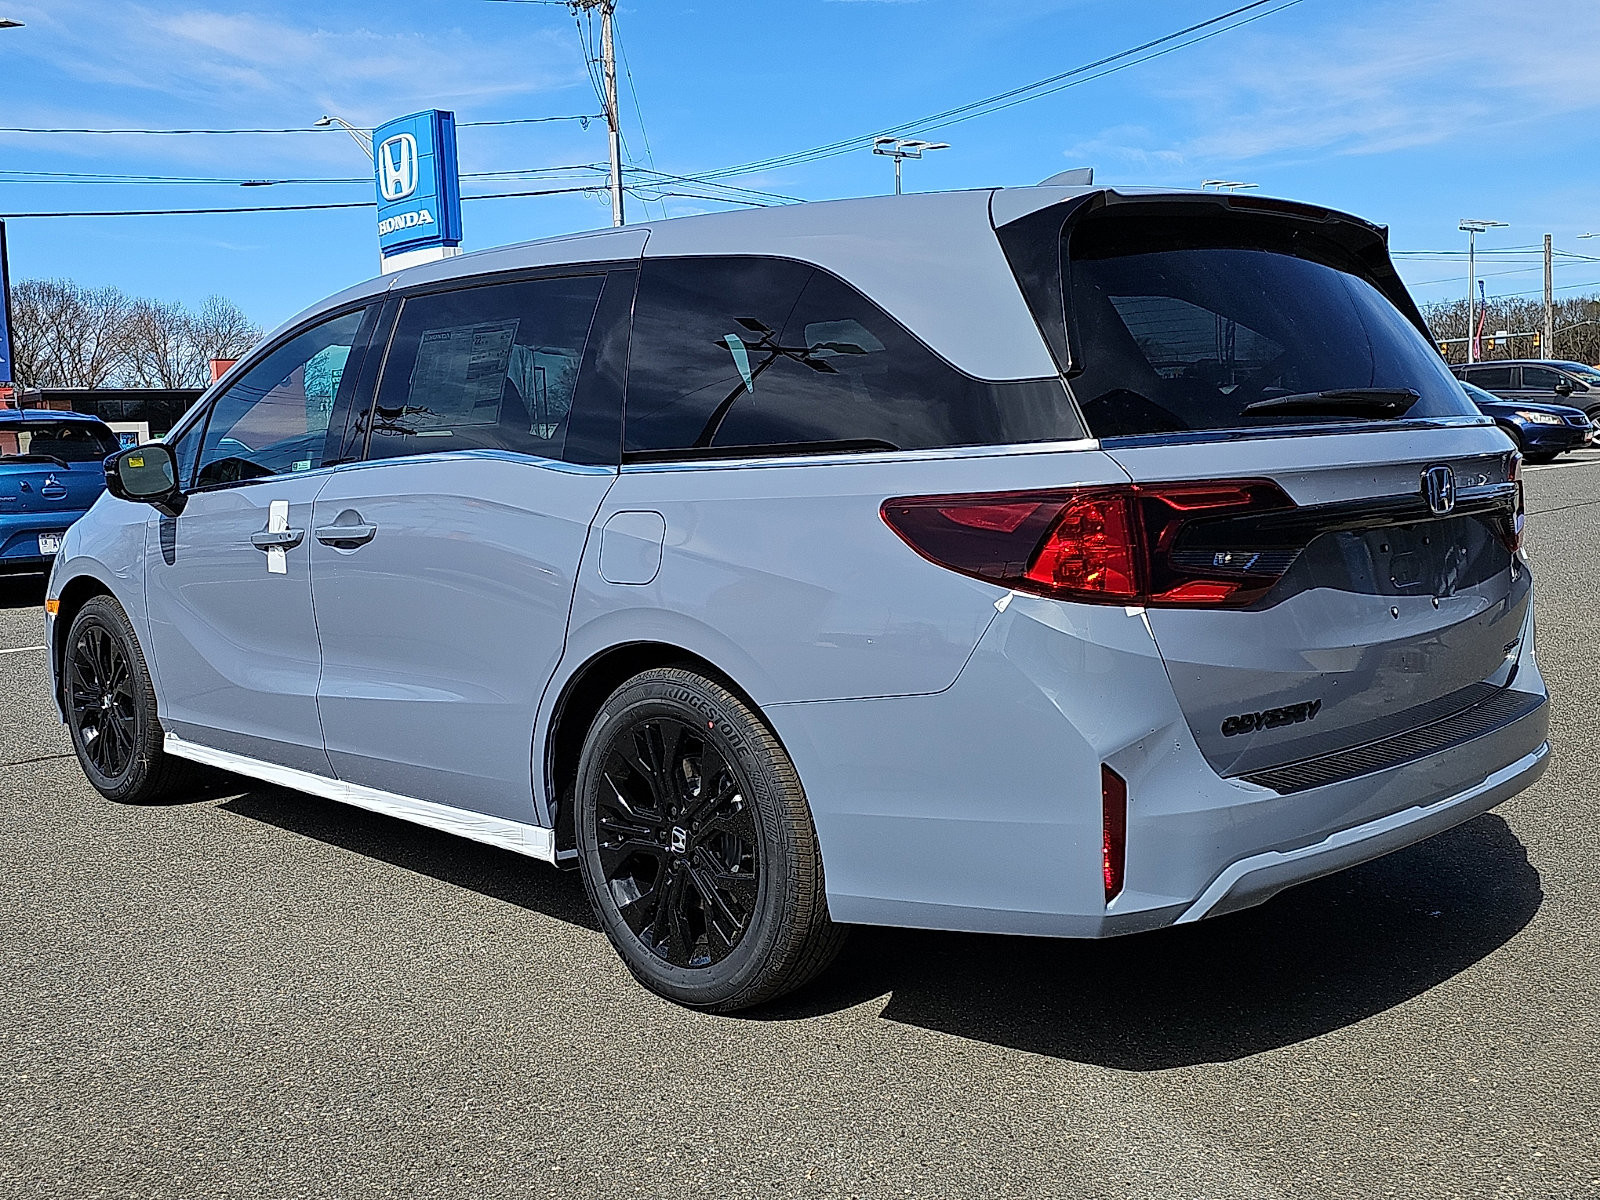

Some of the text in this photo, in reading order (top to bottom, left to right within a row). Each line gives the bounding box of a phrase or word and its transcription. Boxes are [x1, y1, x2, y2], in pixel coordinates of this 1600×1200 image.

[378, 209, 434, 236] HONDA
[657, 687, 751, 759] RIDGESTONE
[1221, 698, 1322, 737] ODYSSEY
